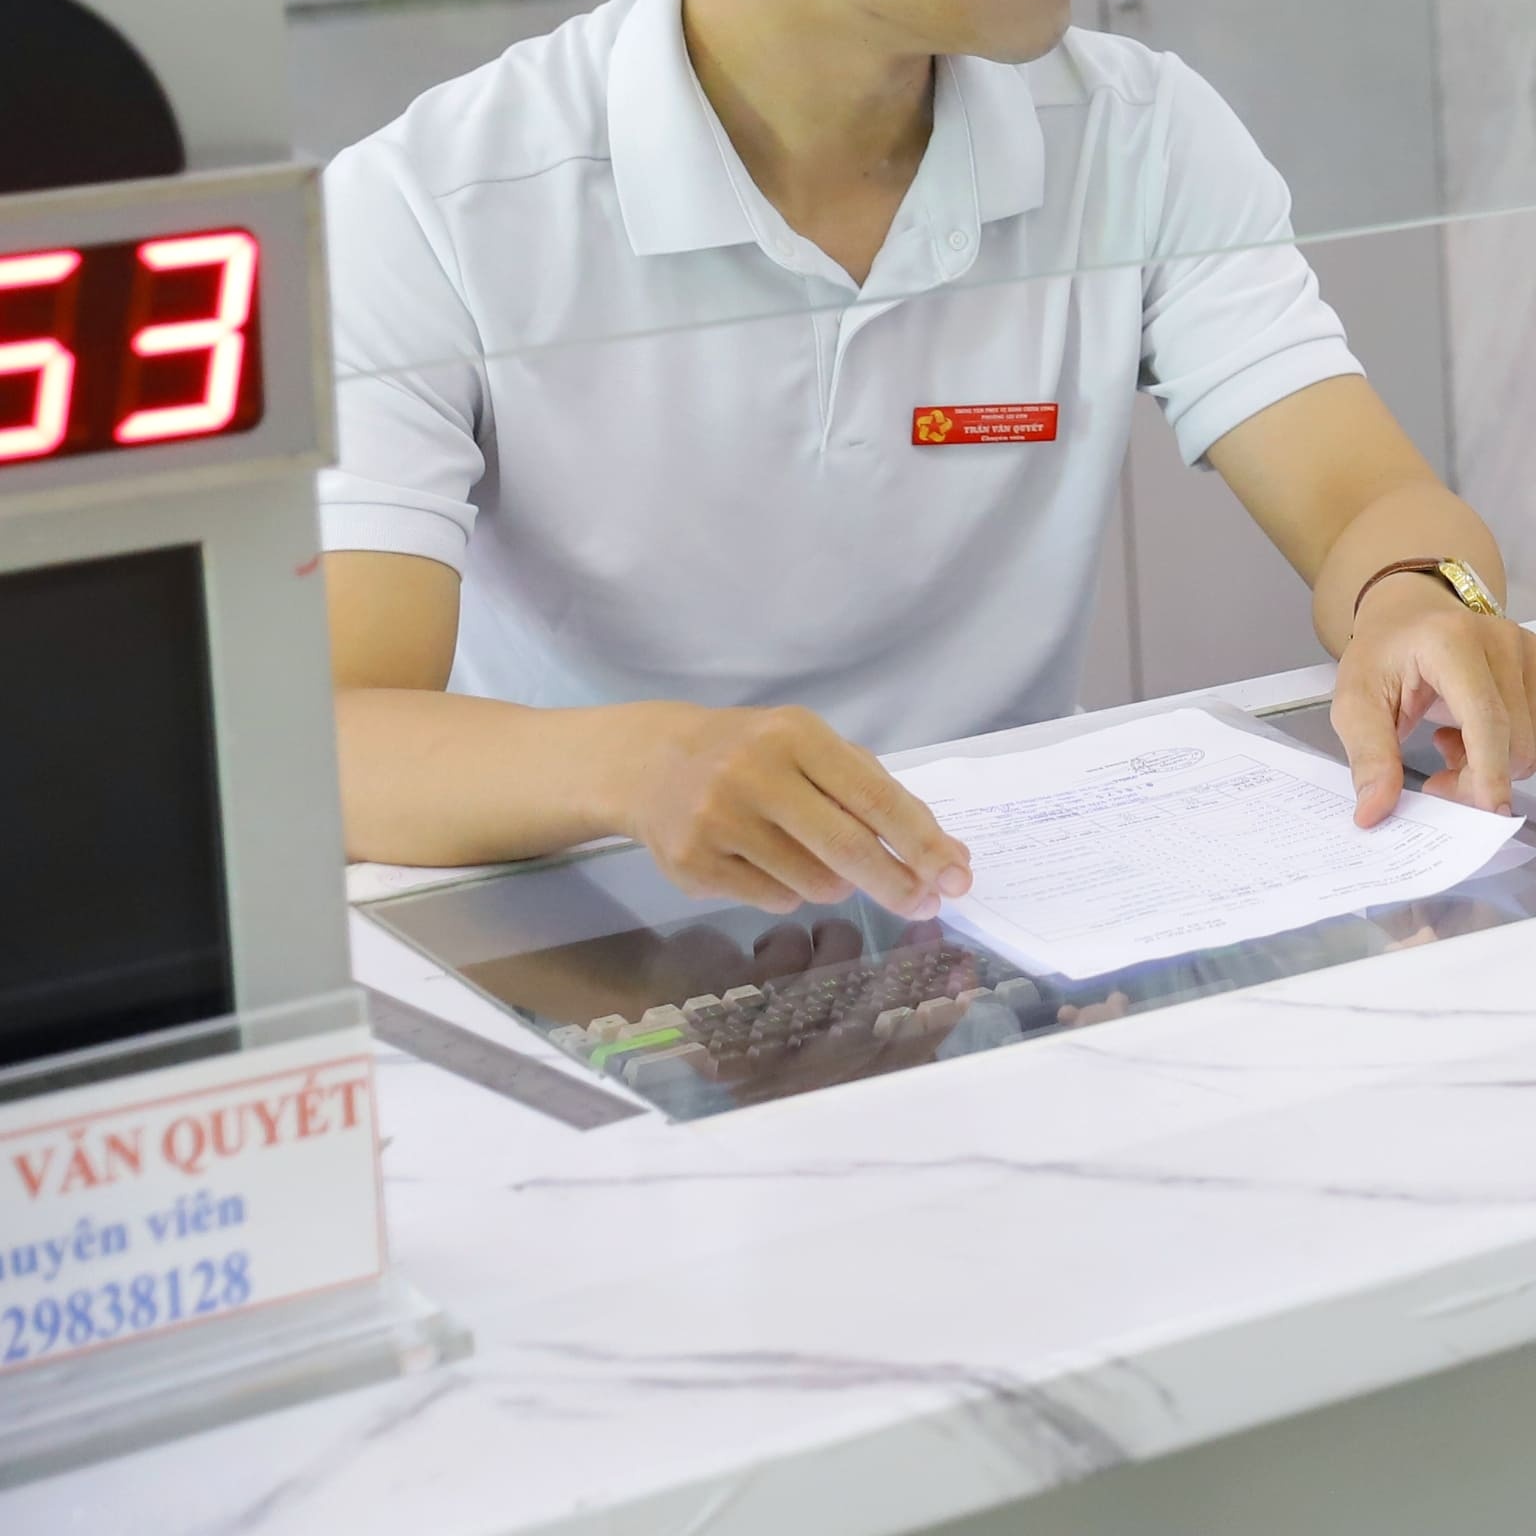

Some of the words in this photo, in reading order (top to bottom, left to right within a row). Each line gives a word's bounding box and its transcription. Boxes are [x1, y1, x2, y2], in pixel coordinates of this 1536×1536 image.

[12, 1126, 148, 1199] VĂN
[161, 1065, 368, 1176] QUYẾT
[146, 1188, 246, 1242] viên
